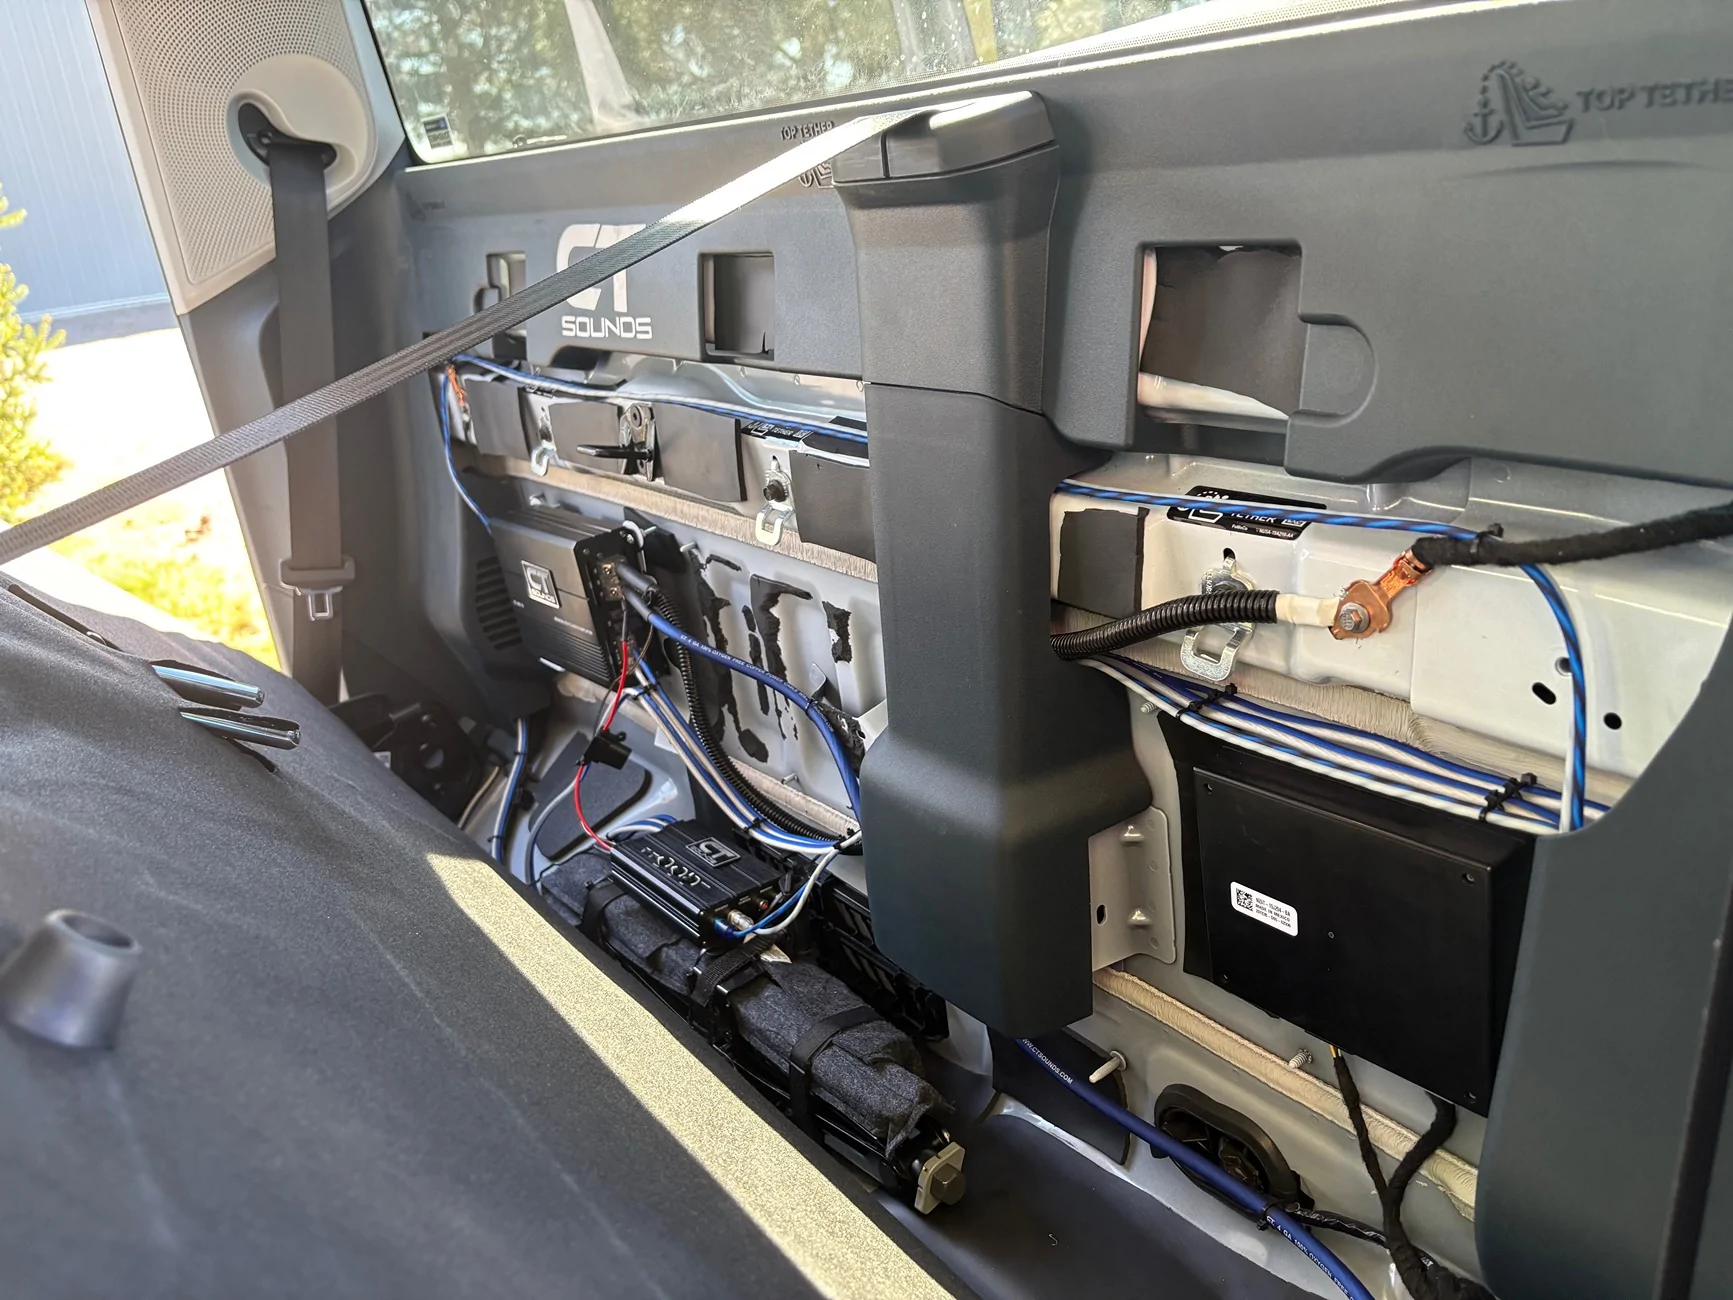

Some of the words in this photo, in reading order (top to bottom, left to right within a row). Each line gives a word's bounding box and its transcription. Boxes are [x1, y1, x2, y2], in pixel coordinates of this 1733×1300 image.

[1576, 87, 1636, 113] TOP
[1640, 78, 1733, 108] TETHE
[780, 125, 798, 140] TOP
[556, 223, 647, 313] CT
[562, 315, 653, 340] SOUNDS
[525, 565, 551, 594] CT
[711, 649, 732, 661] OXYGEN
[732, 657, 745, 666] FREE
[699, 840, 736, 860] CT
[1022, 1038, 1073, 1084] WW.CTSOUNDS.COM
[1283, 1230, 1292, 1240] GA
[1294, 1239, 1309, 1255] 100%
[1309, 1252, 1332, 1278] OXYGEN
[1333, 1277, 1349, 1295] FREE
